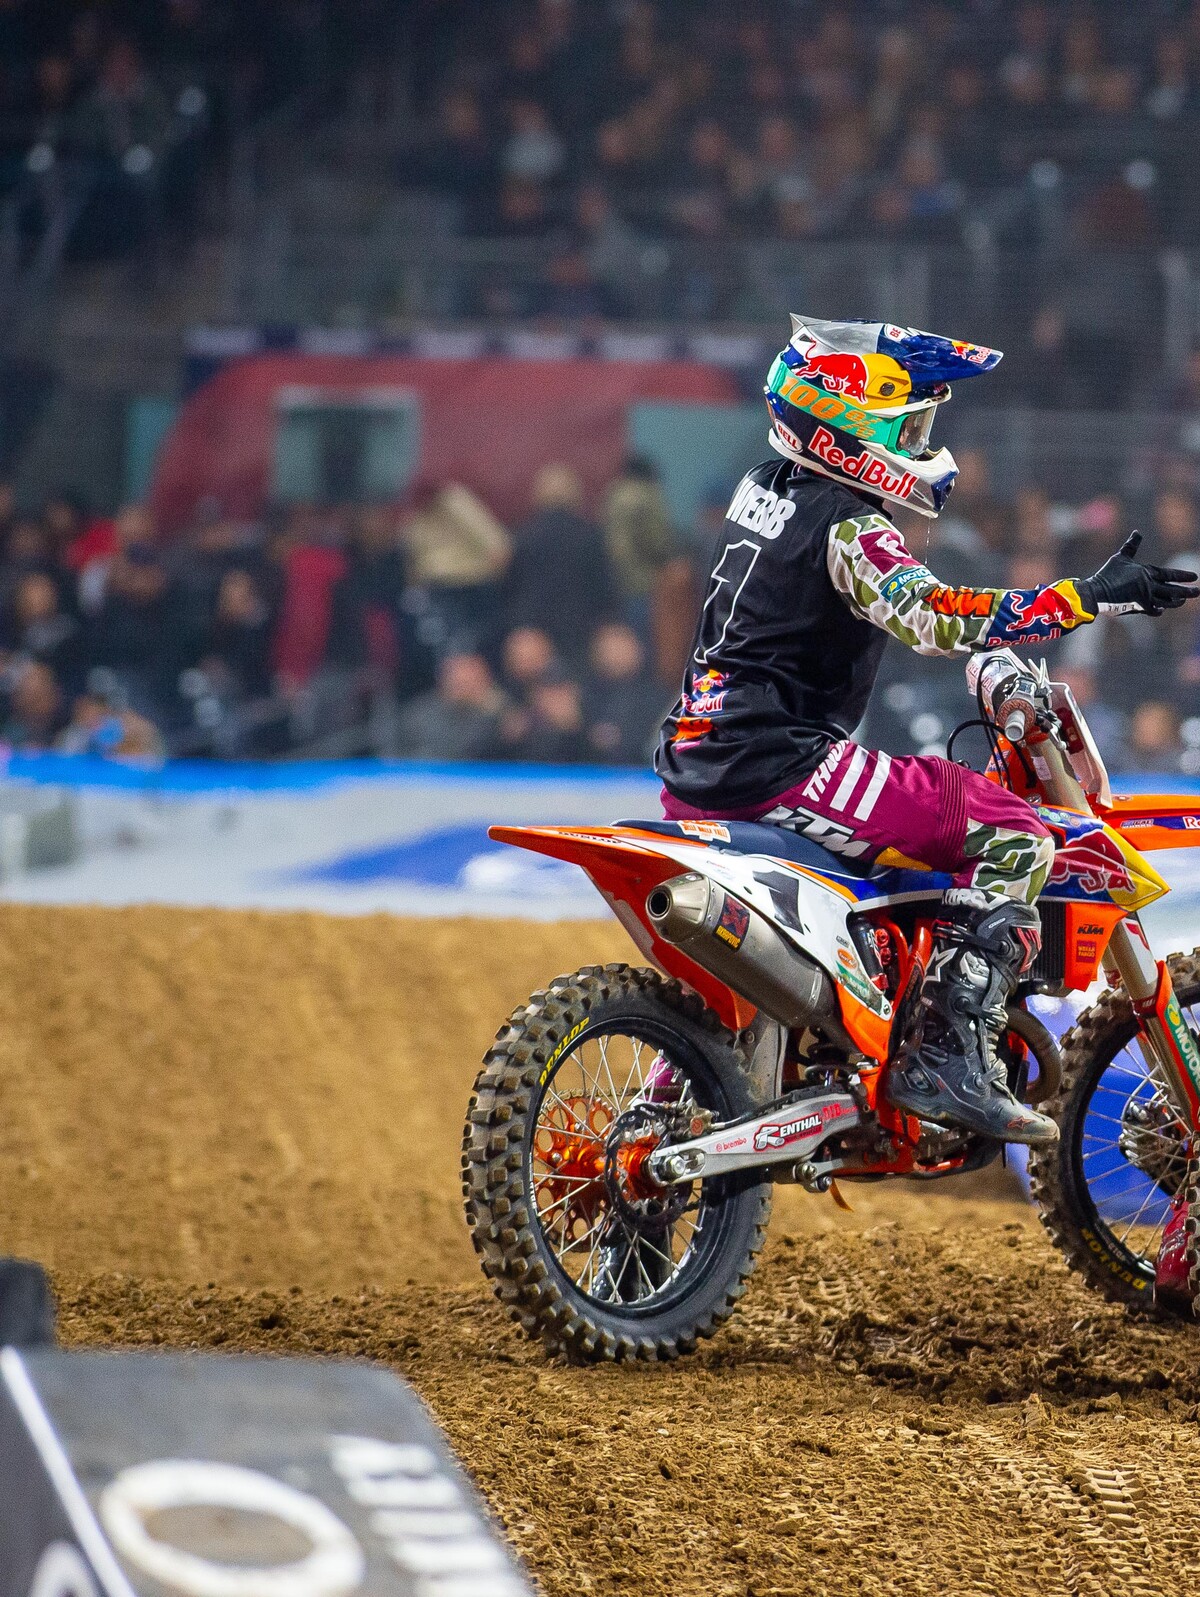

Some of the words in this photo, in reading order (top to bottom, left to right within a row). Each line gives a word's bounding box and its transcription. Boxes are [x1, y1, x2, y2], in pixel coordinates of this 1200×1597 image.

[777, 422, 798, 450] BELL
[779, 377, 882, 439] 100%
[808, 426, 870, 478] Red
[860, 451, 920, 499] Bull
[725, 478, 796, 539] WEBB
[752, 870, 805, 935] 1
[1077, 923, 1104, 935] KTM
[540, 1017, 590, 1086] DUNLOP
[723, 1138, 747, 1150] brembo
[756, 1115, 822, 1149] RENTHAL
